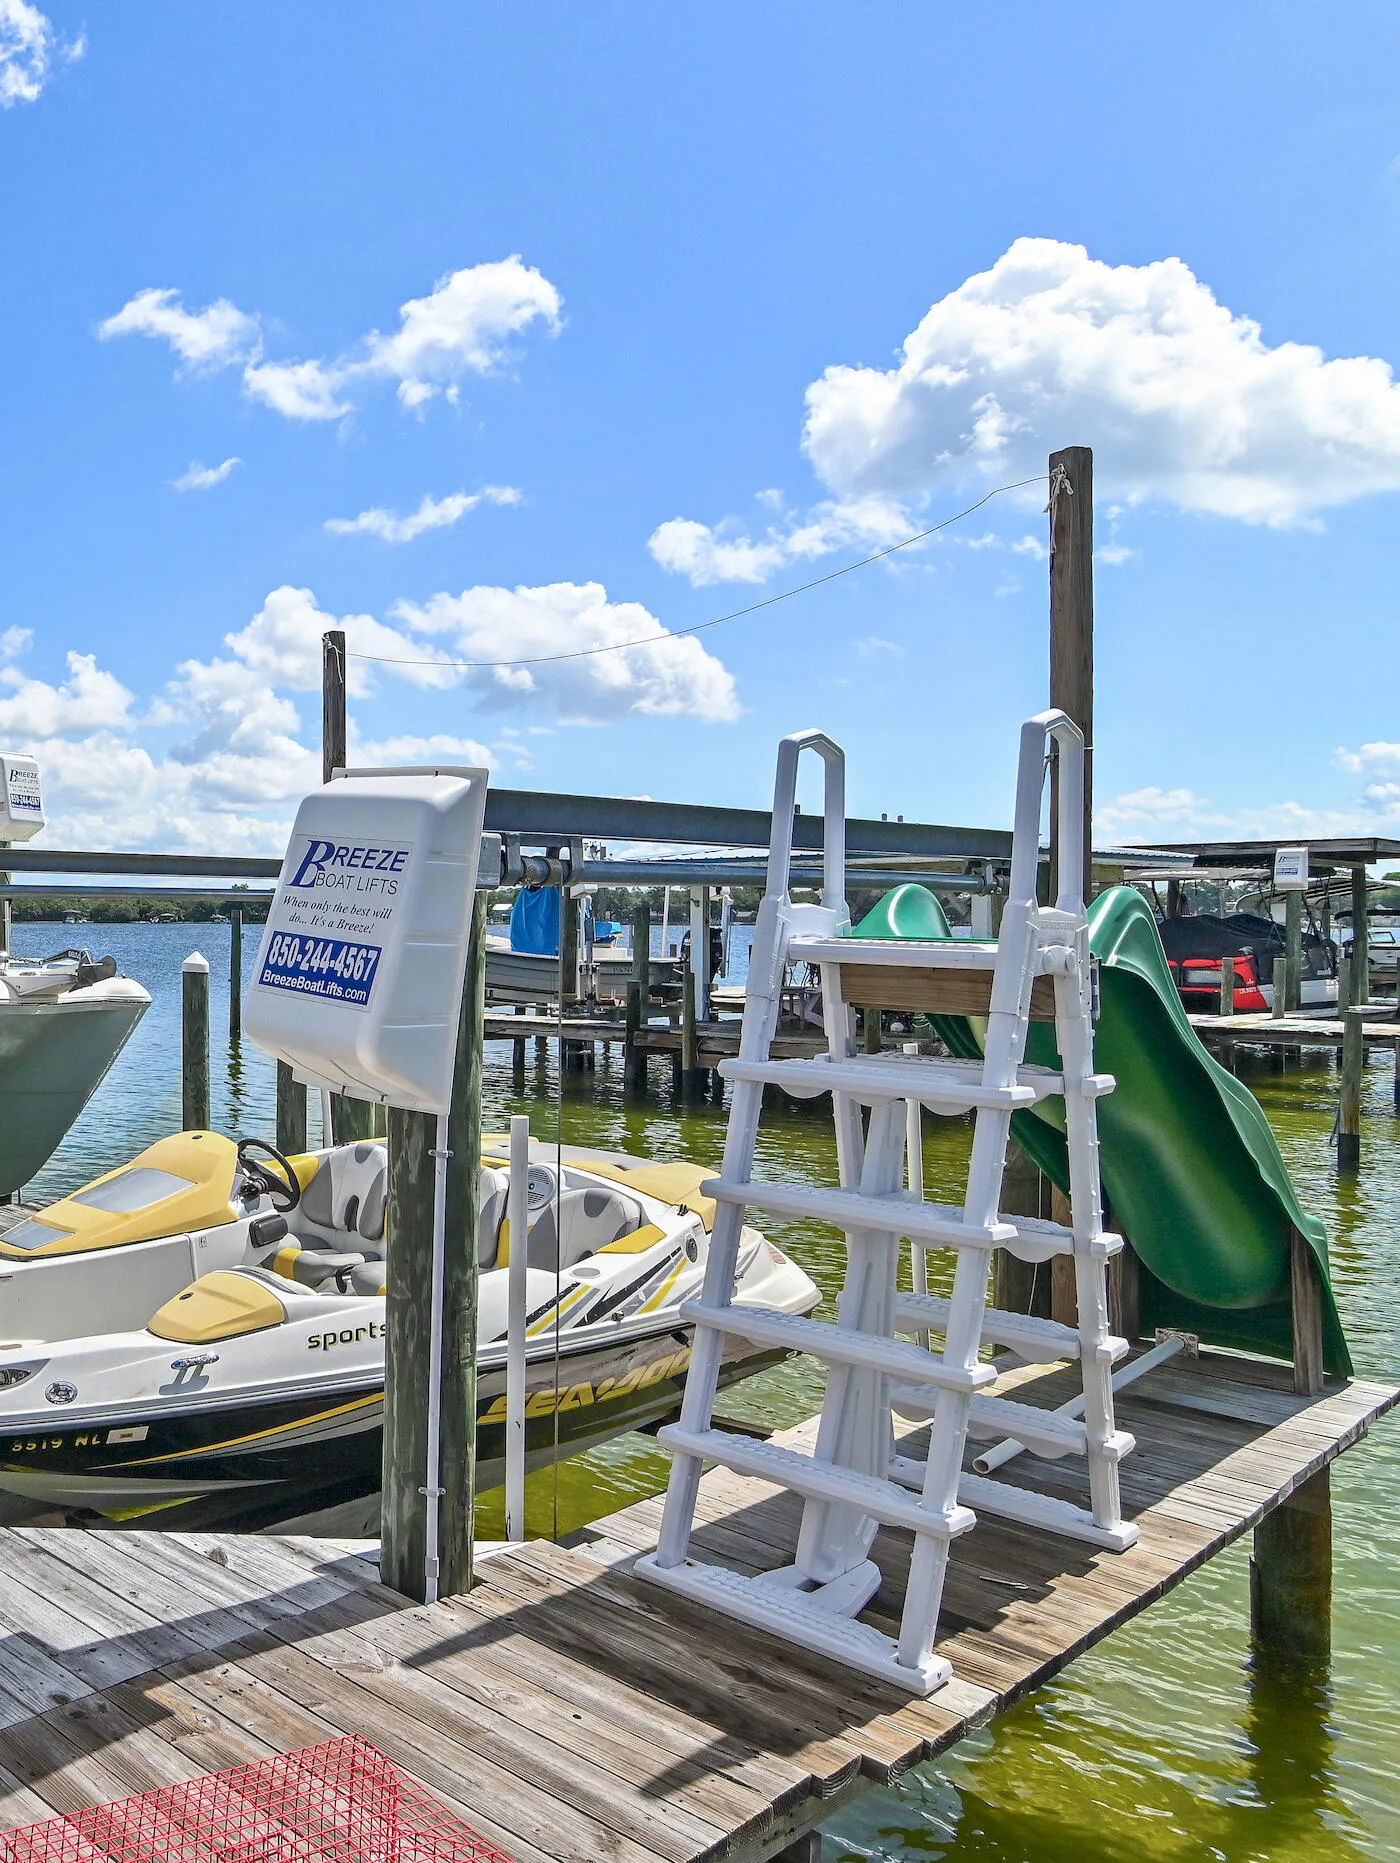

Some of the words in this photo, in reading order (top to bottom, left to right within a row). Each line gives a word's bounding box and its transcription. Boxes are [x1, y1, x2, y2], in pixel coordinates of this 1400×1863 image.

[9, 769, 39, 783] BREEZE
[285, 839, 409, 888] BREEZE
[315, 871, 355, 891] BOAT
[356, 876, 399, 895] LIFTS
[283, 895, 309, 909] When
[310, 900, 332, 914] only
[332, 902, 349, 914] the
[350, 904, 371, 917] best
[372, 907, 393, 920] will
[288, 912, 307, 925] do...
[310, 914, 327, 927] It's
[327, 920, 334, 928] a
[336, 918, 375, 934] Breeze!
[268, 934, 378, 983] 850-244-4567
[612, 966, 633, 974] PAN
[262, 969, 367, 1002] BreezeBoatLifts.com
[74, 1434, 101, 1448] NL
